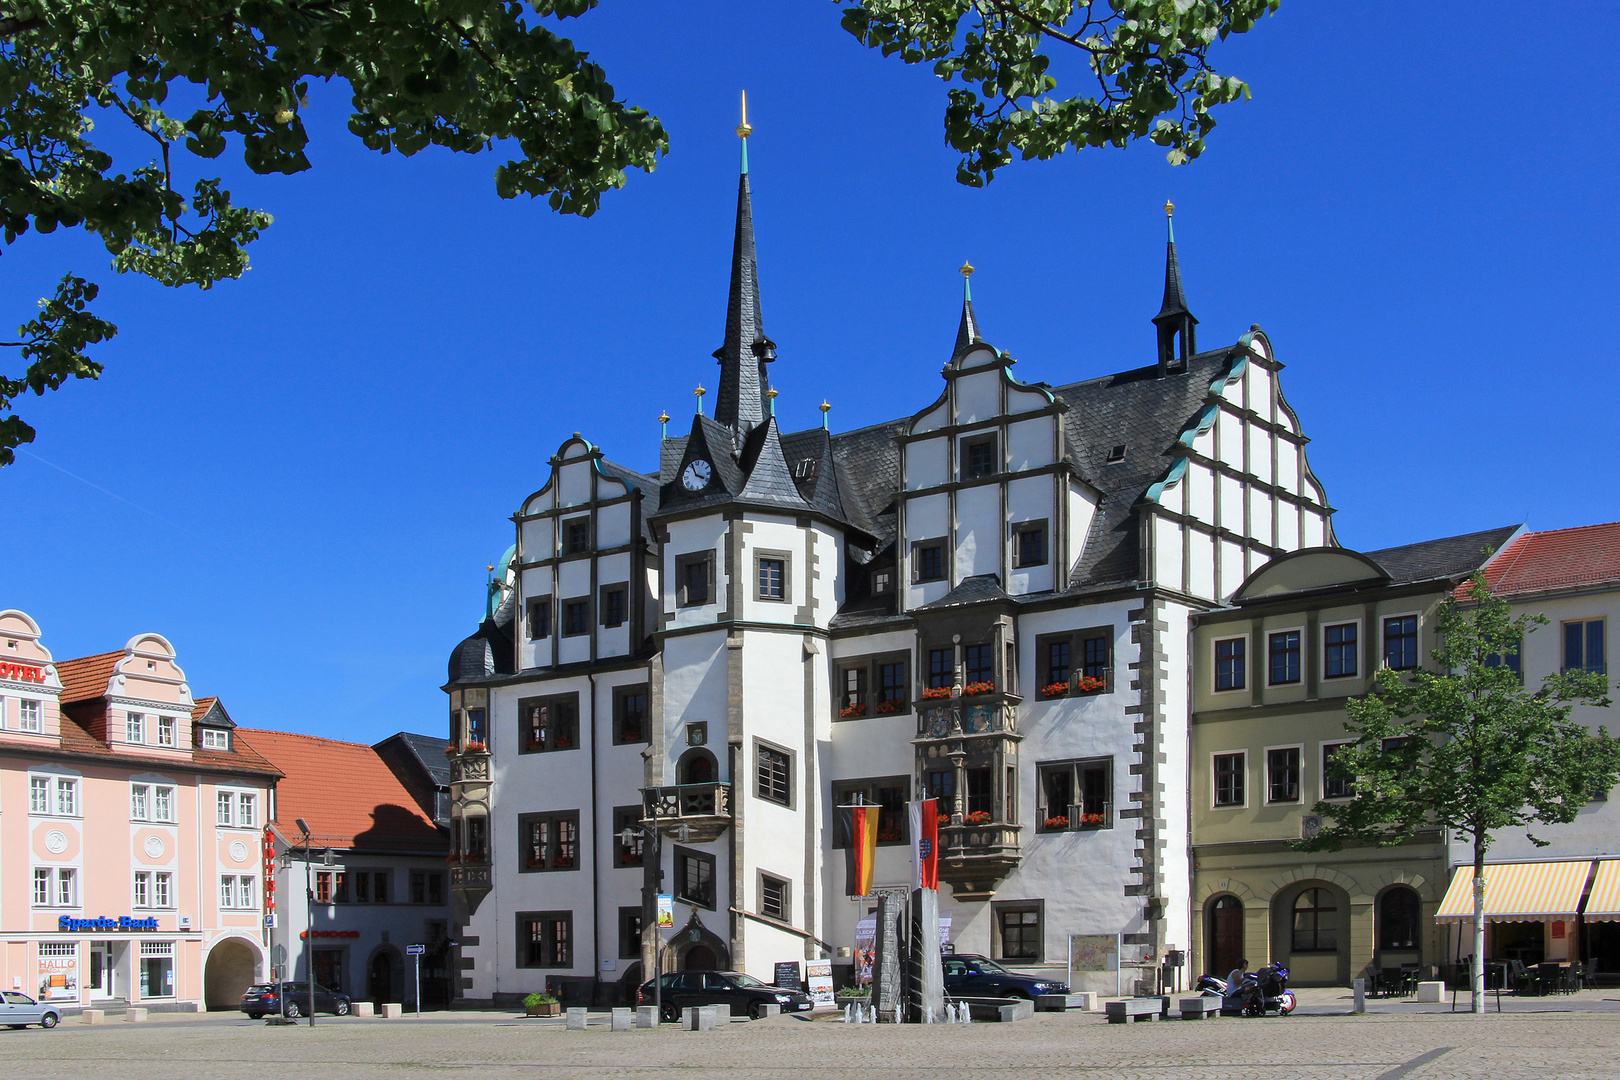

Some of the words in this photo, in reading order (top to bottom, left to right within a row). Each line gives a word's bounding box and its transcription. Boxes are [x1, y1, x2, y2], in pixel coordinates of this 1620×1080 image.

[0, 662, 46, 681] OTEL
[264, 831, 276, 908] HOTEL
[59, 915, 159, 931] Sparda-Bank
[39, 959, 76, 968] HALLO
